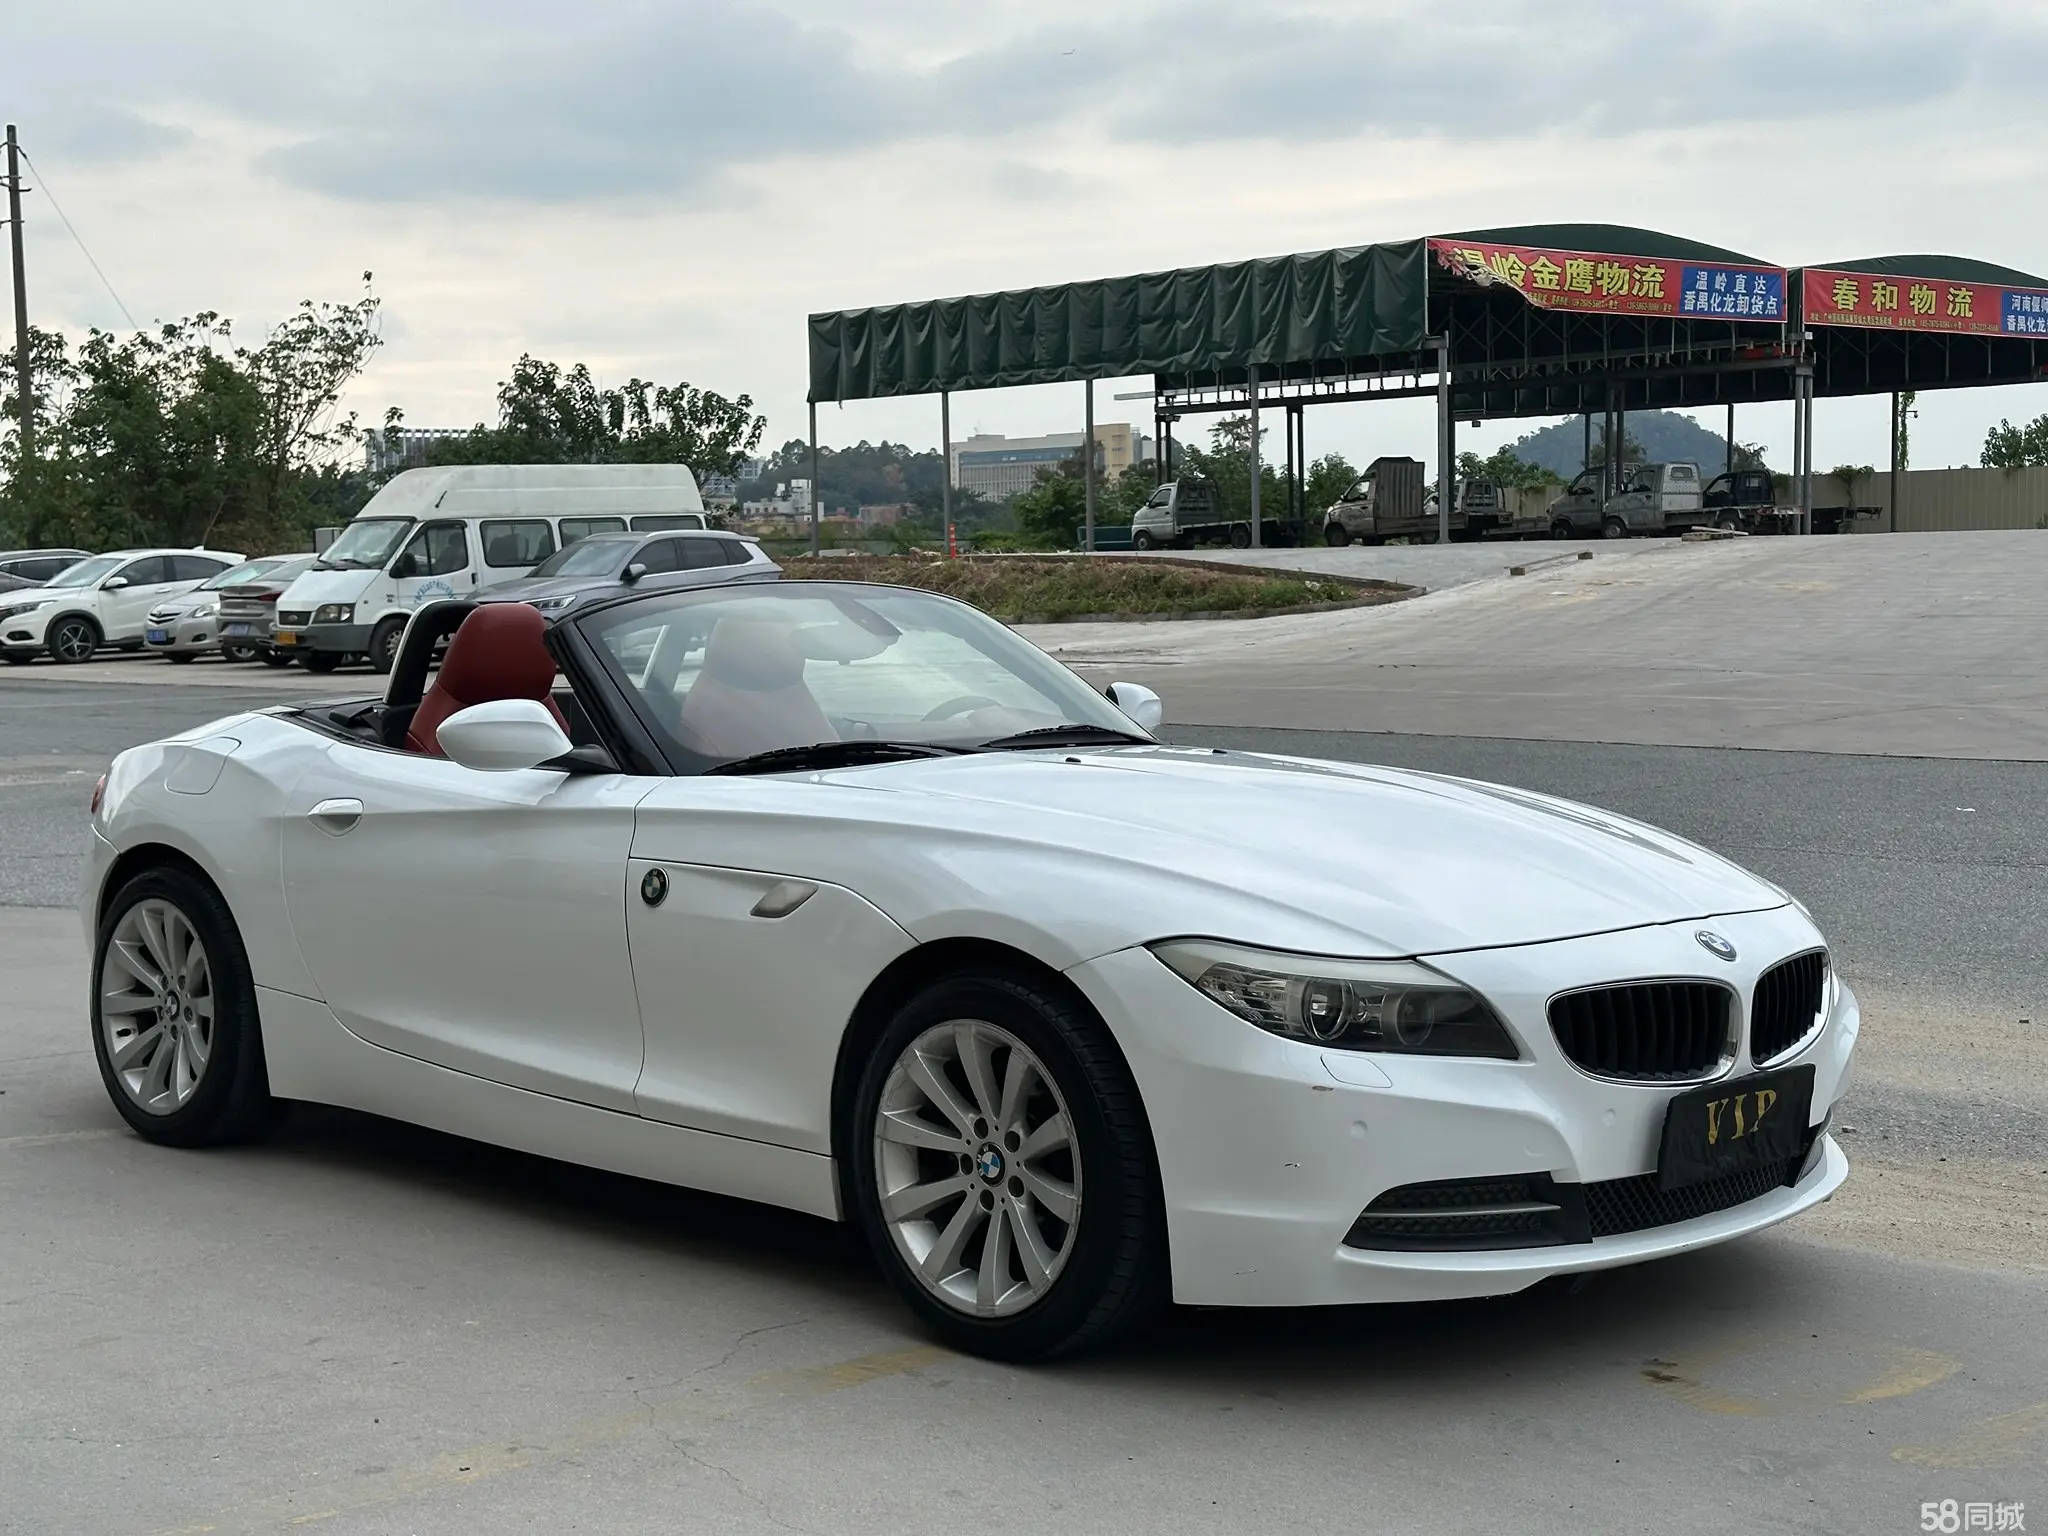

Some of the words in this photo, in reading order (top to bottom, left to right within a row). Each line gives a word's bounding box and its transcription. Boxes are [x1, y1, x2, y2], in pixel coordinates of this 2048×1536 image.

[1695, 270, 1767, 295] 温岭直达
[1684, 291, 1778, 315] 番禺化龙卸货点
[1832, 278, 1974, 318] 春和物流
[2007, 315, 2048, 332] 番禺化龙
[1706, 1089, 1777, 1145] VIP
